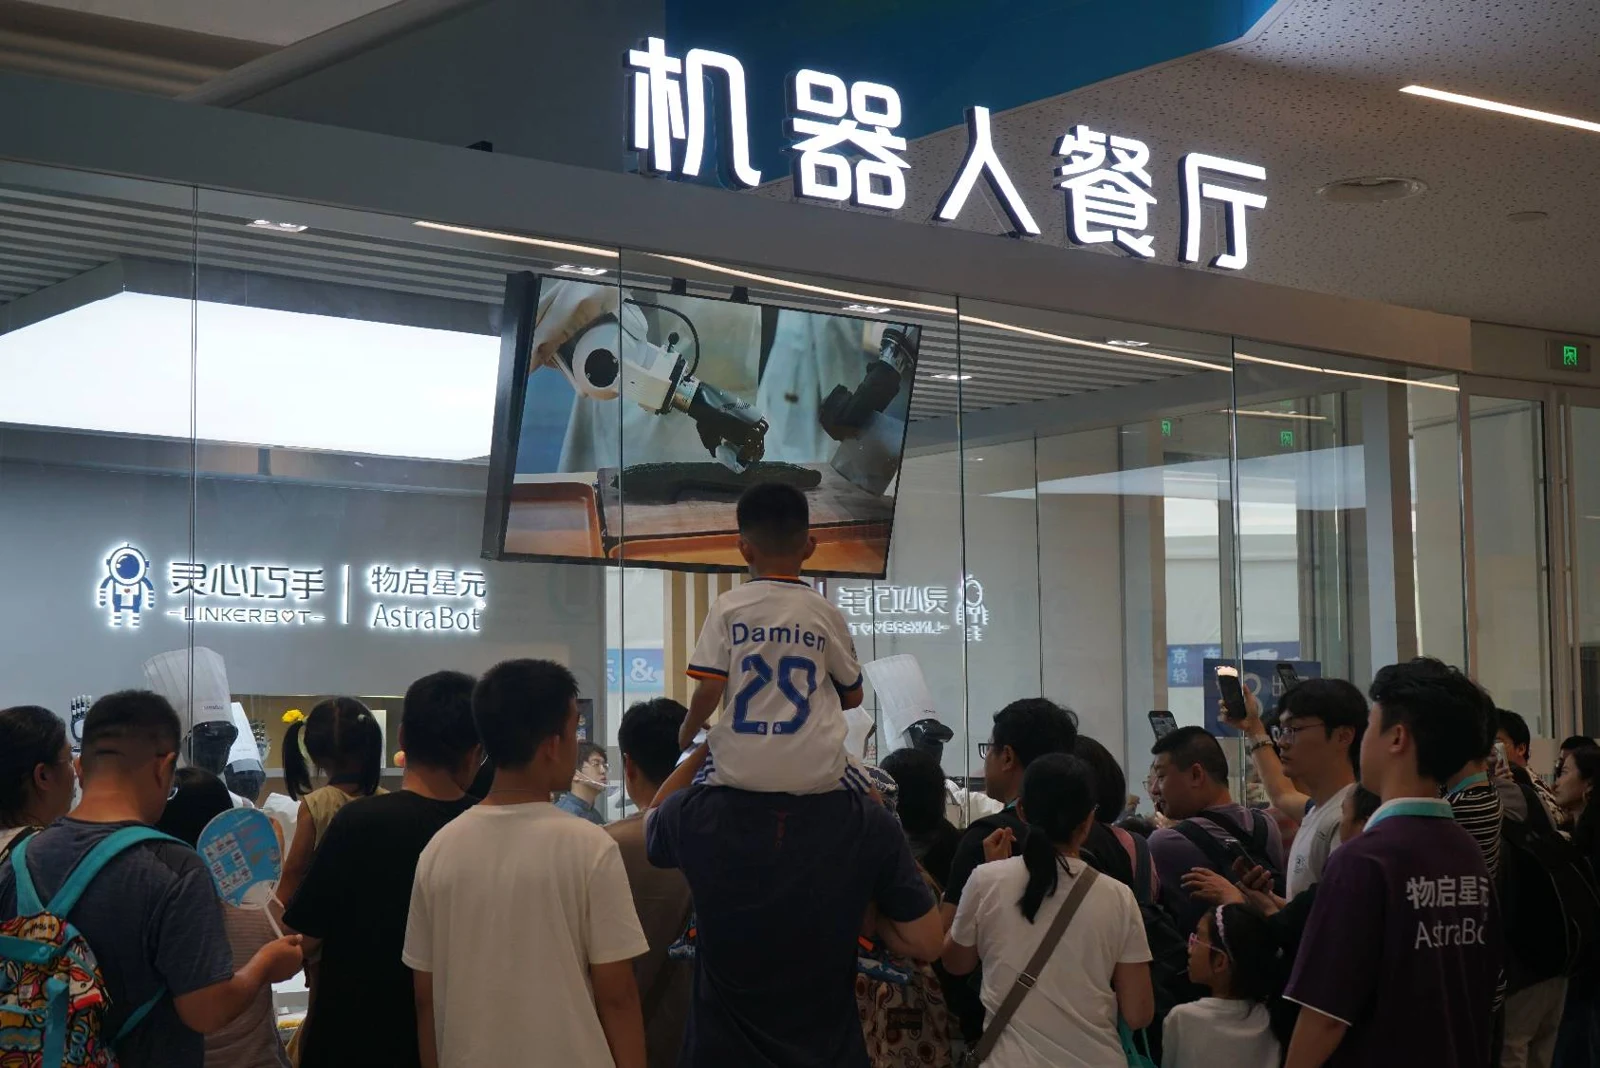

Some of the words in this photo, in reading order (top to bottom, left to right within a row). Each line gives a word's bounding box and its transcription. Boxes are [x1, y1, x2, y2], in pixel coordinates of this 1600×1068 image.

[627, 36, 1268, 270] 机器人餐厅
[171, 561, 326, 600] 灵心巧手
[370, 566, 487, 598] 物启星元
[372, 603, 480, 631] AstraBot
[732, 622, 826, 654] Damien
